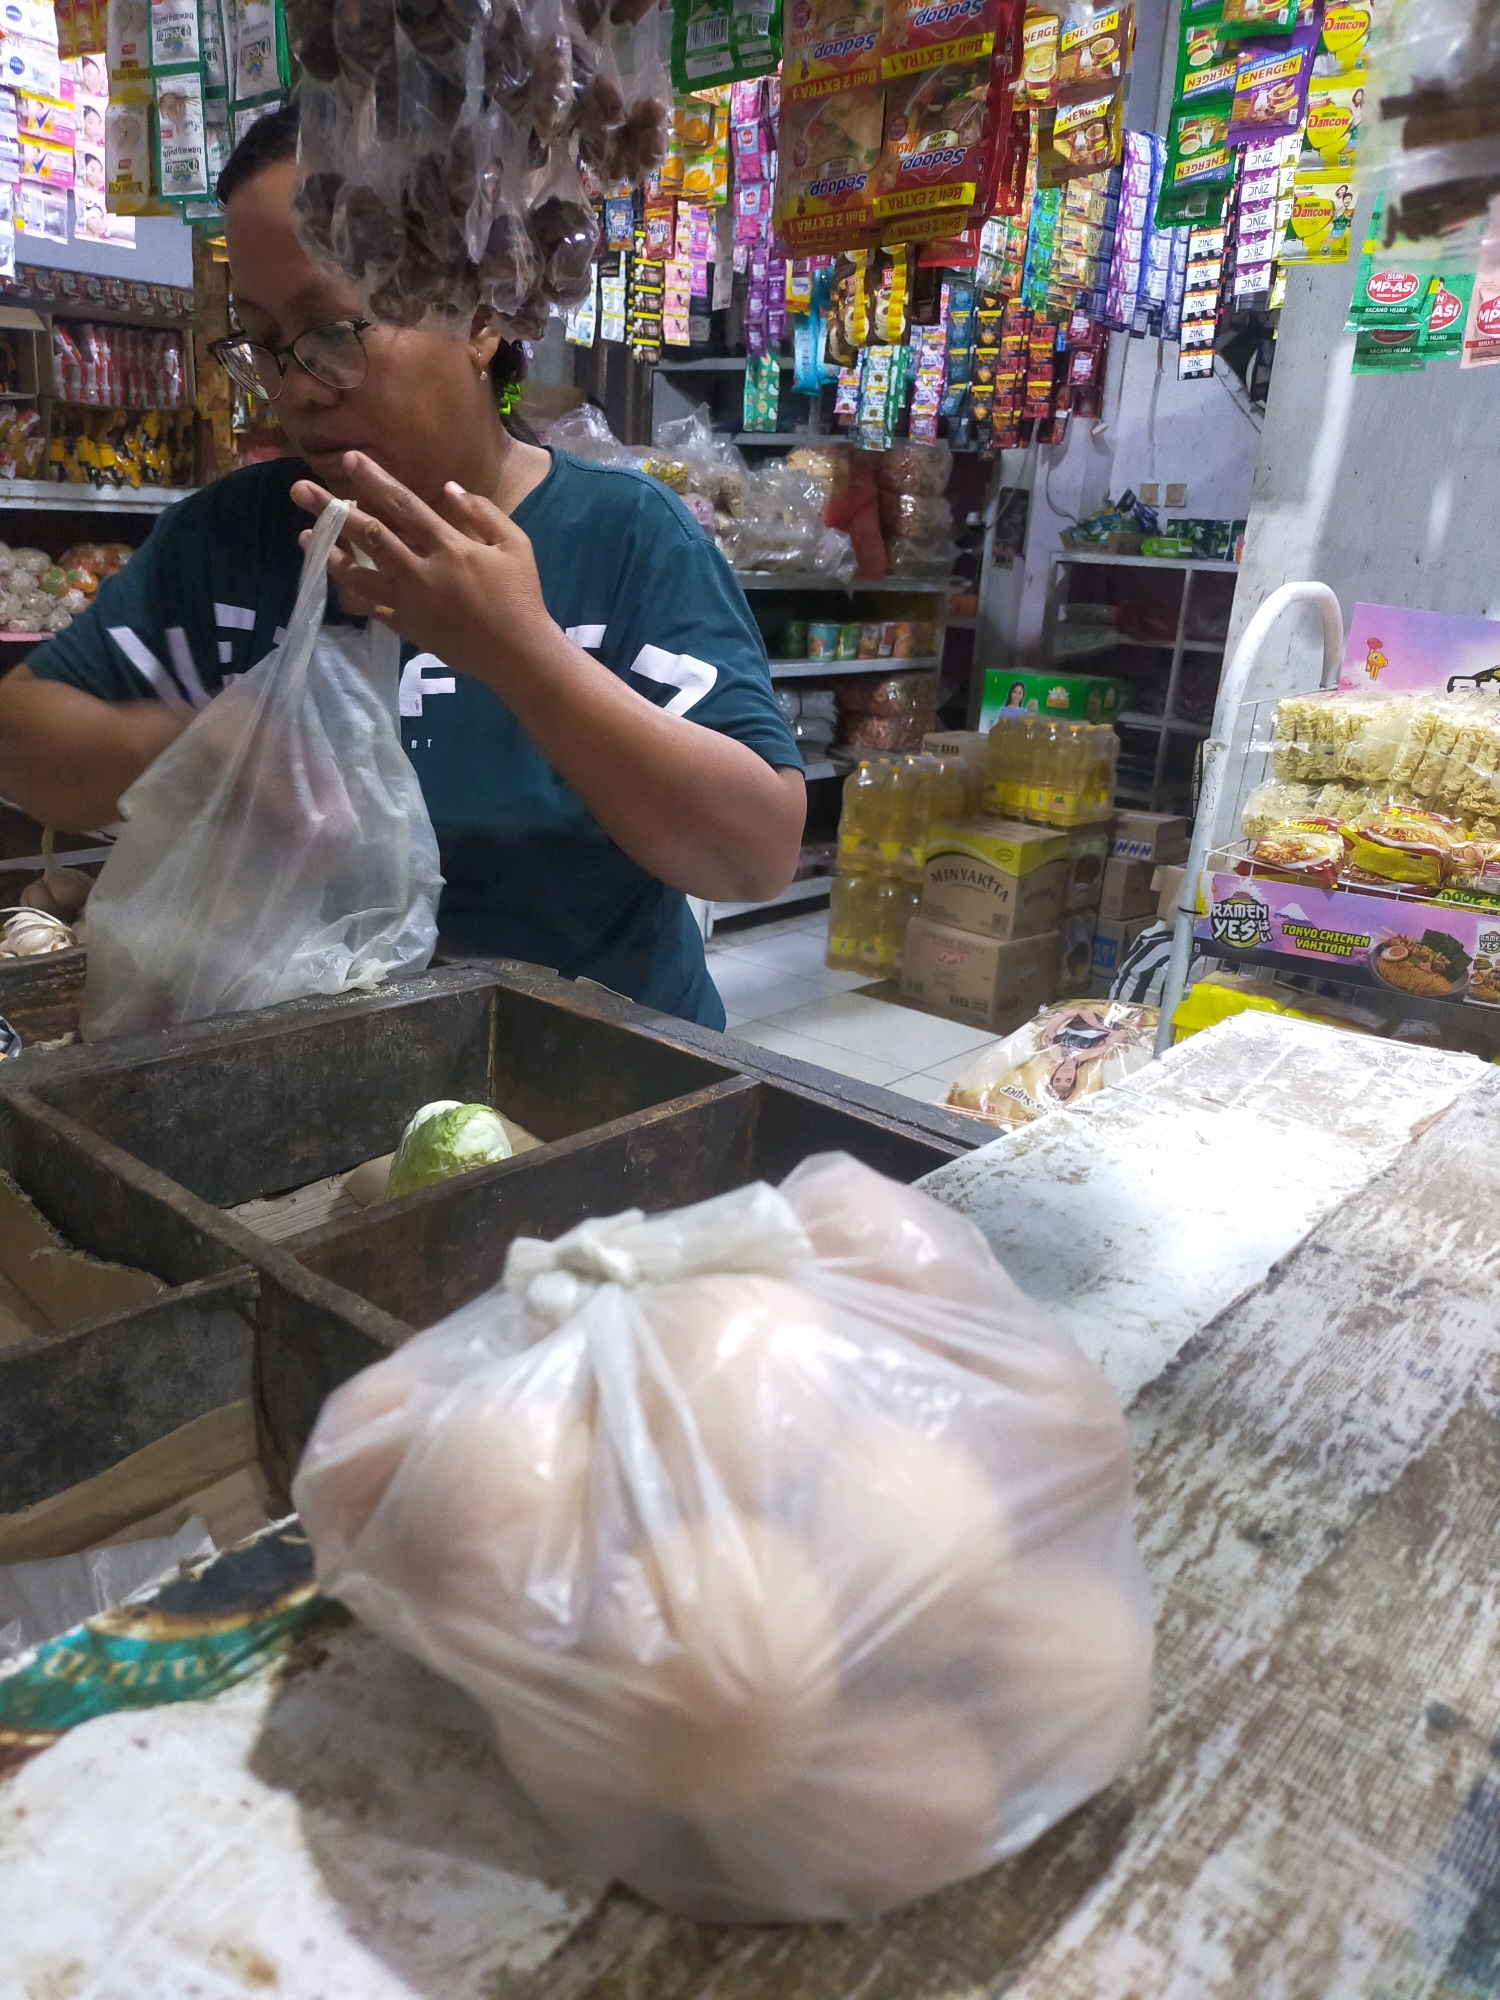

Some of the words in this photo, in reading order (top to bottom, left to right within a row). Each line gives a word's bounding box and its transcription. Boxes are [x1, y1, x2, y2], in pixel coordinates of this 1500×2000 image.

[914, 0, 985, 27] Sedaap
[1323, 17, 1367, 32] Dancow
[1023, 25, 1059, 44] NERGE
[814, 32, 879, 60] Sedaap
[947, 45, 955, 58] 2
[900, 48, 944, 69] EXTRA
[1187, 64, 1237, 88] ENERGEN
[1241, 59, 1298, 85] ENERGEN
[801, 80, 840, 97] EXTRA
[843, 76, 851, 88] 2
[1058, 103, 1106, 128] ENERGEN
[1307, 114, 1350, 128] Dancow
[902, 147, 967, 171] Sedaap
[1177, 153, 1226, 177] ENERGEN
[810, 173, 869, 196] Sedaap
[888, 192, 927, 212] EXTRA
[927, 190, 936, 203] 2
[939, 186, 962, 202] Beli
[836, 213, 843, 226] 2
[846, 208, 867, 225] Beli
[1292, 204, 1332, 218] Dancow
[647, 223, 670, 234] Molto
[796, 214, 834, 232] EXTRA
[1197, 236, 1214, 248] ZINC
[1194, 268, 1211, 279] ZINC
[1368, 280, 1417, 293] MP-ASI
[1191, 299, 1207, 309] ZINC
[1189, 328, 1206, 338] ZINC
[1187, 358, 1204, 368] ZINC
[930, 868, 1009, 904] MINYAKITA
[1212, 903, 1269, 919] RAMEN
[1213, 919, 1257, 942] YES
[1258, 920, 1272, 942] はい
[1282, 923, 1318, 939] TOKYO
[1319, 928, 1371, 948] CHICKEN
[1295, 938, 1353, 957] YAKITORI
[1480, 942, 1500, 950] YES
[1001, 1085, 1035, 1108] Super
